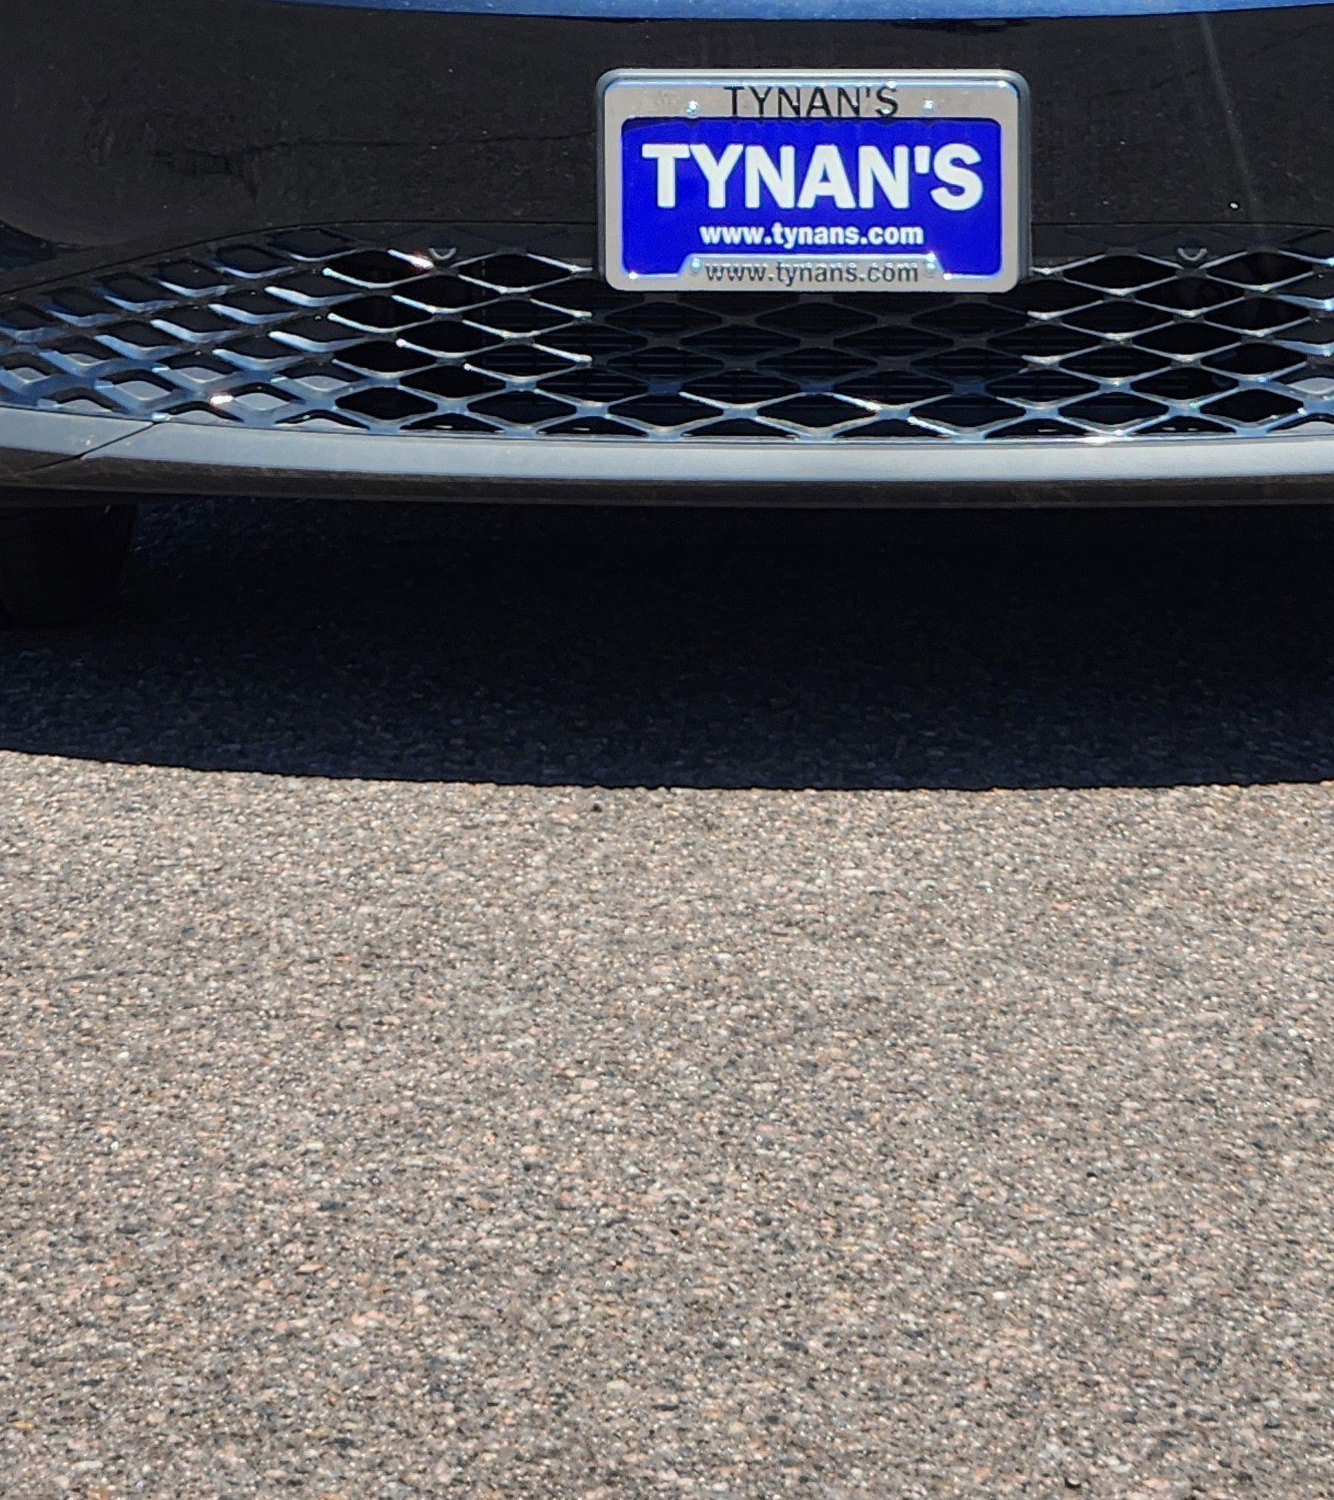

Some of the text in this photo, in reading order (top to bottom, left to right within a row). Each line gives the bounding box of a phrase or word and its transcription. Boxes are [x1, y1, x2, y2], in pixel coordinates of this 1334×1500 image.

[724, 86, 899, 118] TYNAN'S
[642, 142, 984, 211] TYNAN'S
[700, 222, 924, 249] www.tynans.com
[705, 261, 919, 287] www.tynans.com
